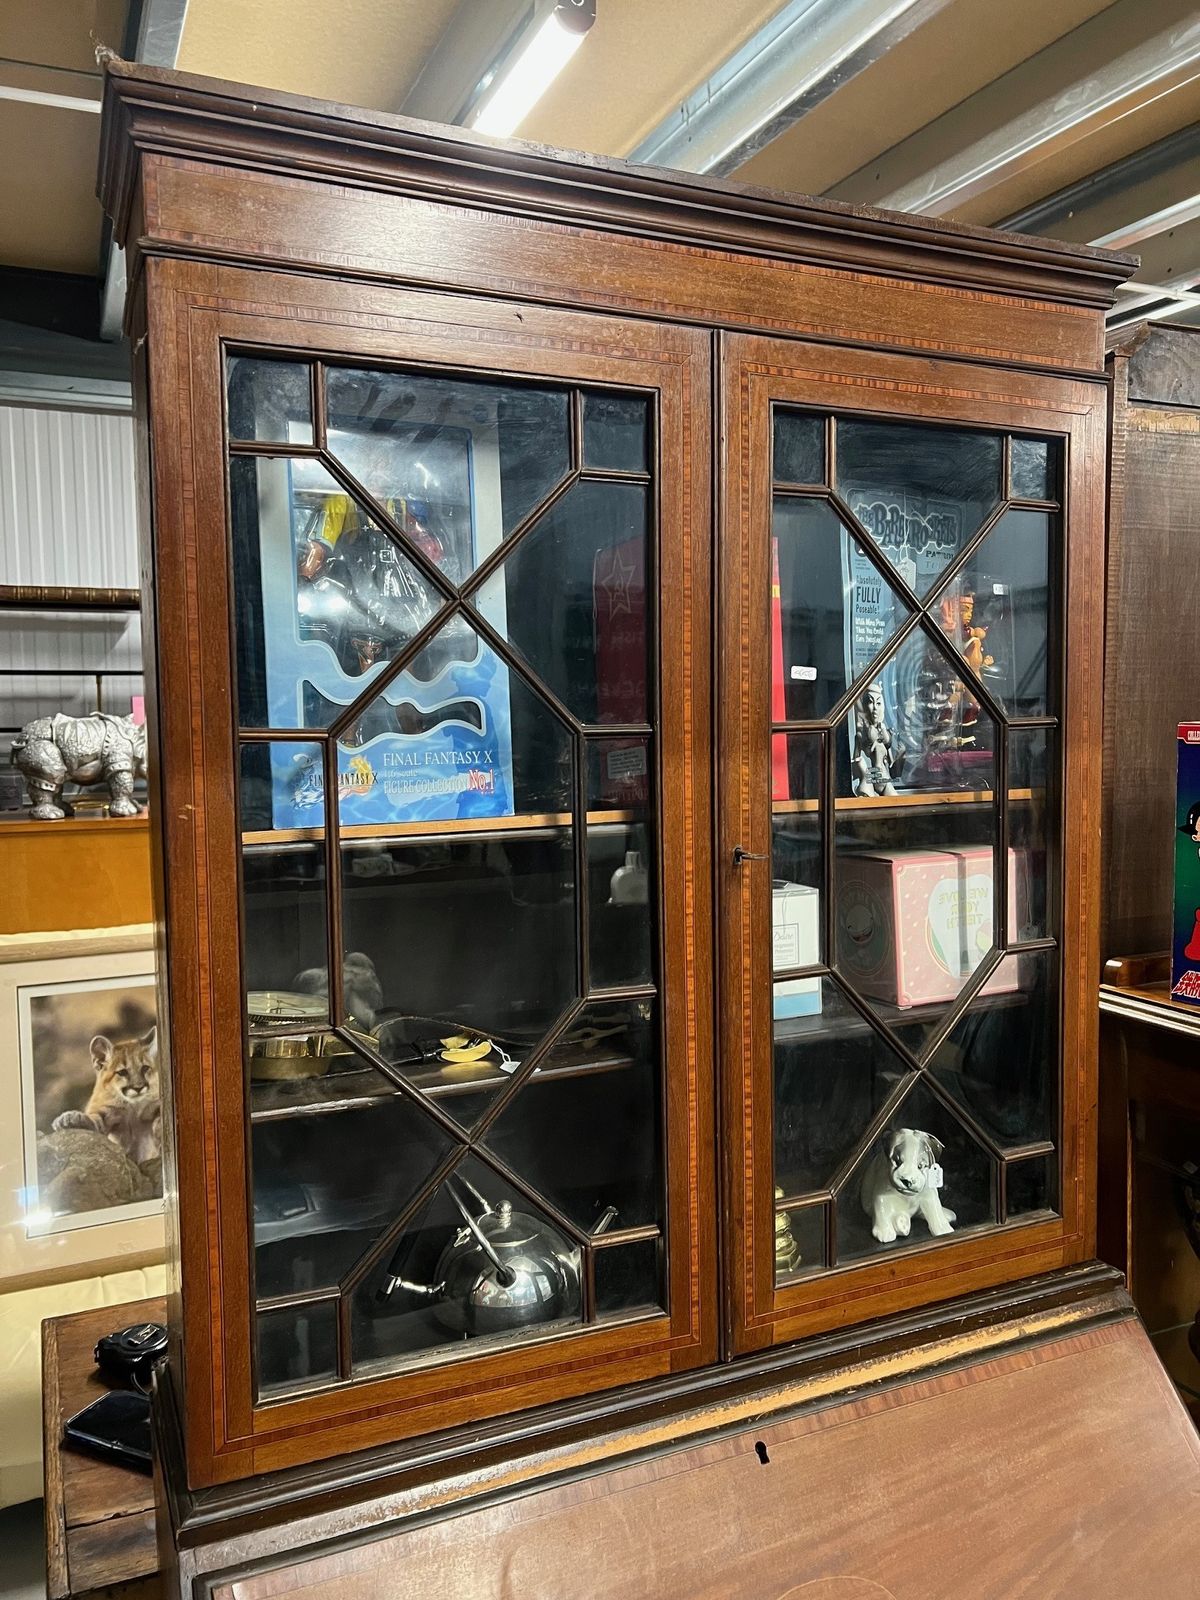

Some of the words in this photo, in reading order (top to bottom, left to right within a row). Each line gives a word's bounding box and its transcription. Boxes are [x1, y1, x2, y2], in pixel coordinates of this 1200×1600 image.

[856, 586, 881, 604] FULLY
[855, 604, 880, 615] Poseable!
[383, 752, 421, 767] FINAL
[424, 750, 481, 766] FANTASY
[483, 749, 494, 764] X
[339, 772, 370, 786] ANTASY
[371, 772, 379, 785] X
[383, 779, 415, 794] FIGURE
[415, 775, 469, 793] COLLECTION
[468, 767, 495, 791] No.1
